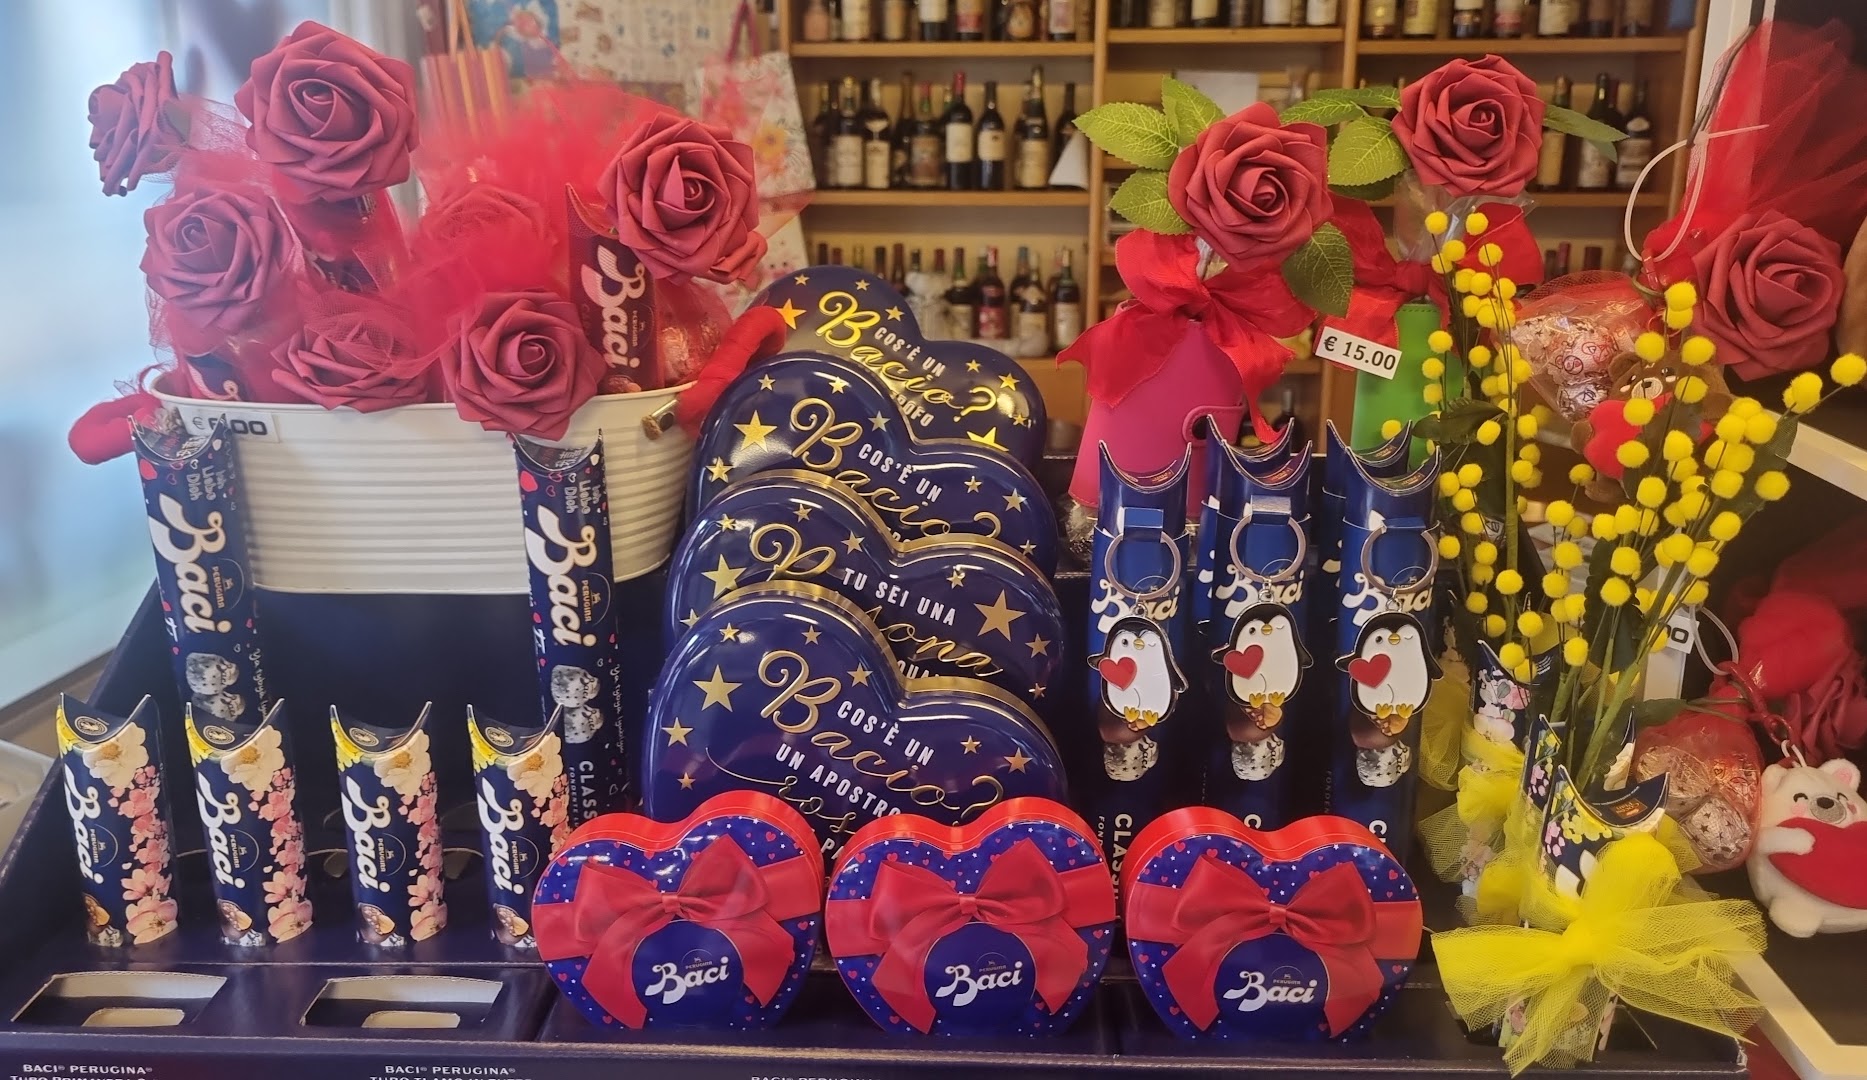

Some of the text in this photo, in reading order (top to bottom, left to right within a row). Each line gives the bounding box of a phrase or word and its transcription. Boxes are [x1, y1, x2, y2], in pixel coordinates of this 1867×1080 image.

[581, 245, 646, 368] Baci
[815, 290, 997, 423] Bacio?
[874, 326, 947, 378] COS'È UN
[1323, 336, 1396, 370] € 15.00
[858, 442, 944, 503] COS'È UN
[148, 492, 232, 633] Baci
[212, 566, 225, 608] PERUGINA
[524, 505, 597, 647] Baci
[581, 580, 592, 622] PERUGINA
[842, 567, 957, 627] TU SEI UNA
[758, 650, 1004, 828] Bacio?
[837, 699, 934, 767] COS'È UN
[579, 760, 599, 820] CLASS
[775, 743, 901, 817] UN APOSTRO
[64, 763, 104, 884] Baci
[195, 771, 246, 889] Baci
[341, 775, 391, 892] Baci
[477, 777, 524, 894] Baci
[645, 956, 729, 1005] Baci
[935, 961, 1023, 1007] Baci
[1222, 971, 1317, 1012] Baci
